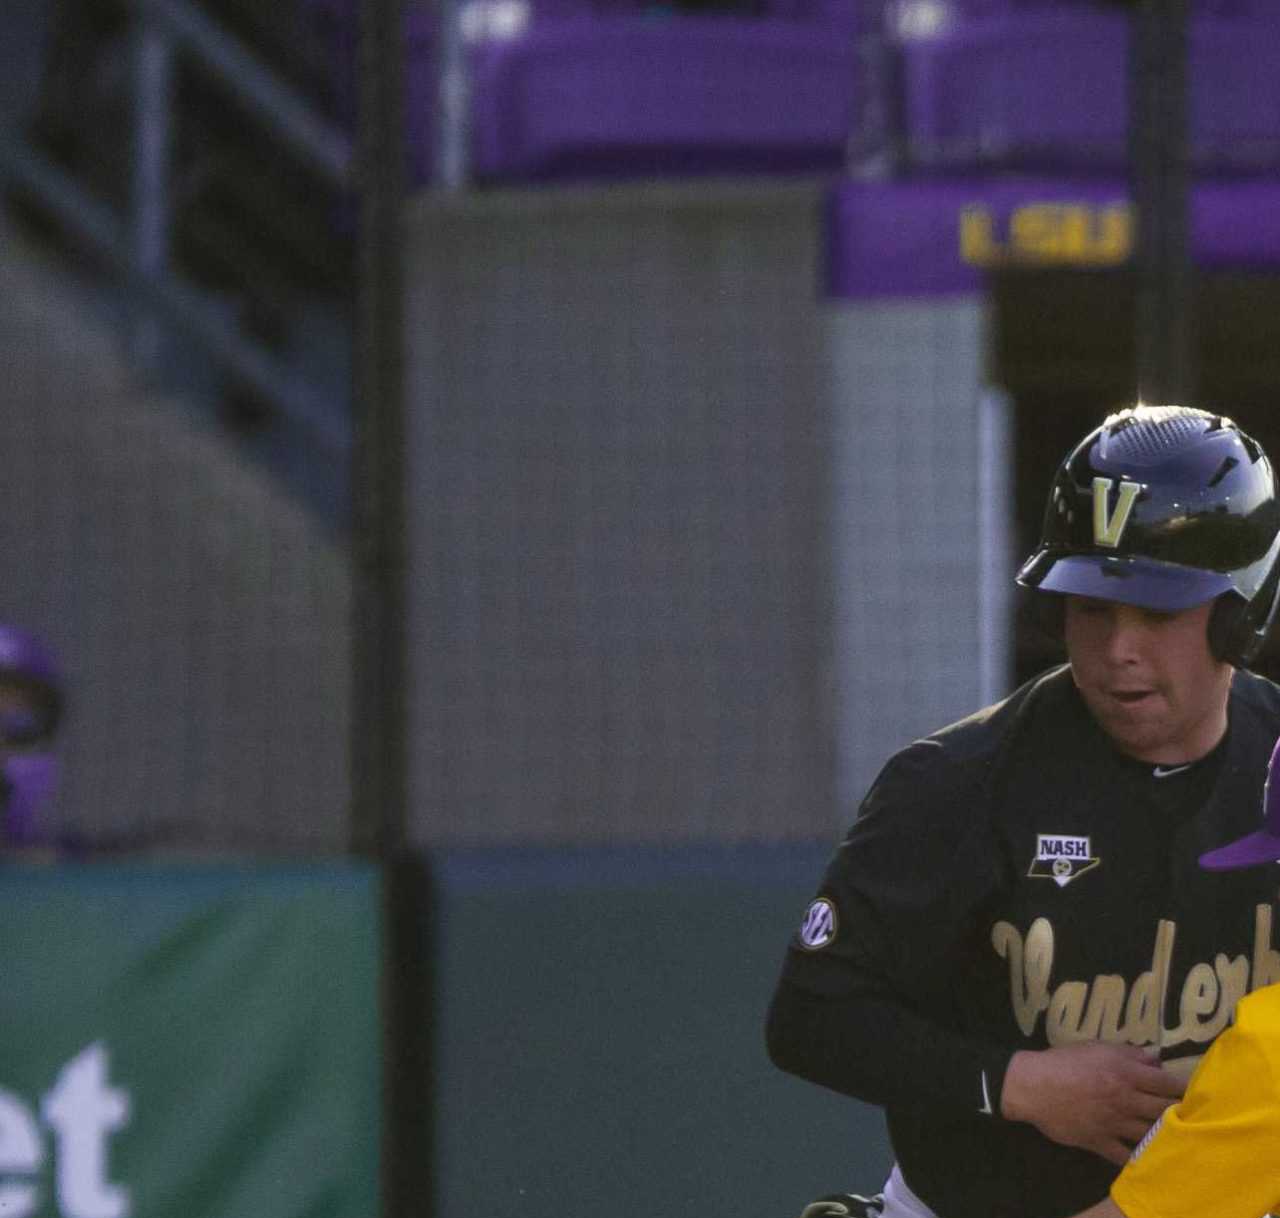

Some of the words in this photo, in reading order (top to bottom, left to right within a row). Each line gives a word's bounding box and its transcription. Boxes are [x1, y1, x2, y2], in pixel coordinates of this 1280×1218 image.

[960, 204, 1131, 267] LSU
[1093, 477, 1141, 548] V
[1040, 839, 1087, 857] NASH
